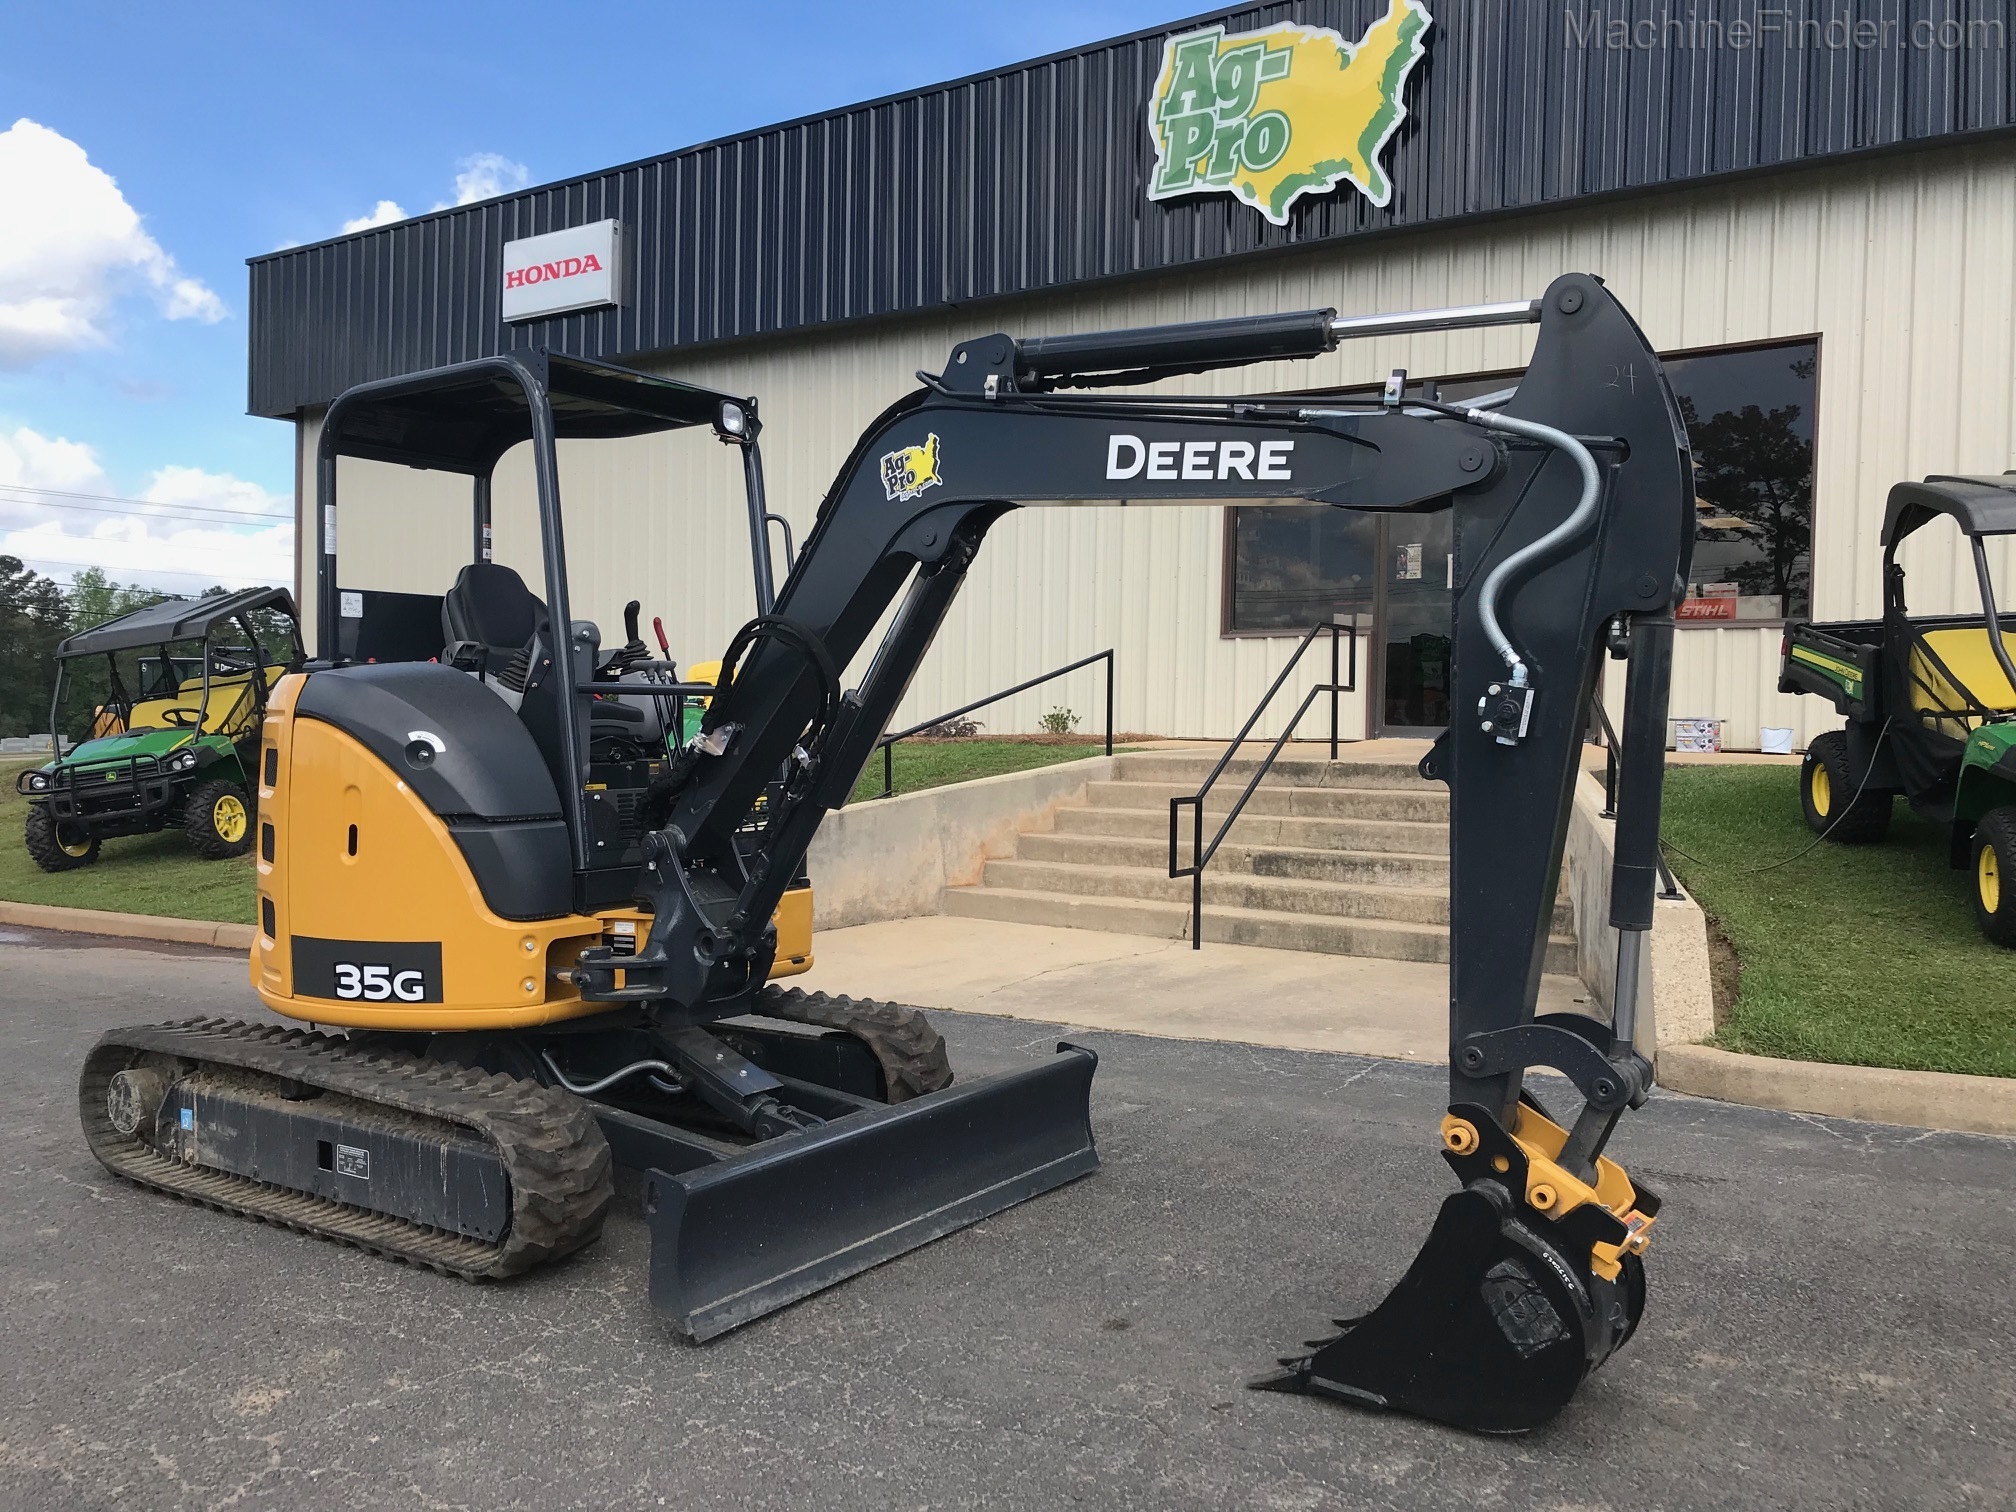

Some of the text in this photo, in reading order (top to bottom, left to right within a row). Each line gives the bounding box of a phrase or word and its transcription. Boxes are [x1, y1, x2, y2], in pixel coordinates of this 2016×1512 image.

[1157, 33, 1292, 122] Ag-
[1157, 109, 1291, 191] Pro
[506, 254, 603, 289] HONDA
[885, 453, 911, 478] Ag-
[1106, 434, 1294, 480] DEERE
[886, 470, 916, 495] Pro
[1680, 604, 1728, 617] STIHL
[335, 963, 424, 1001] 35G
